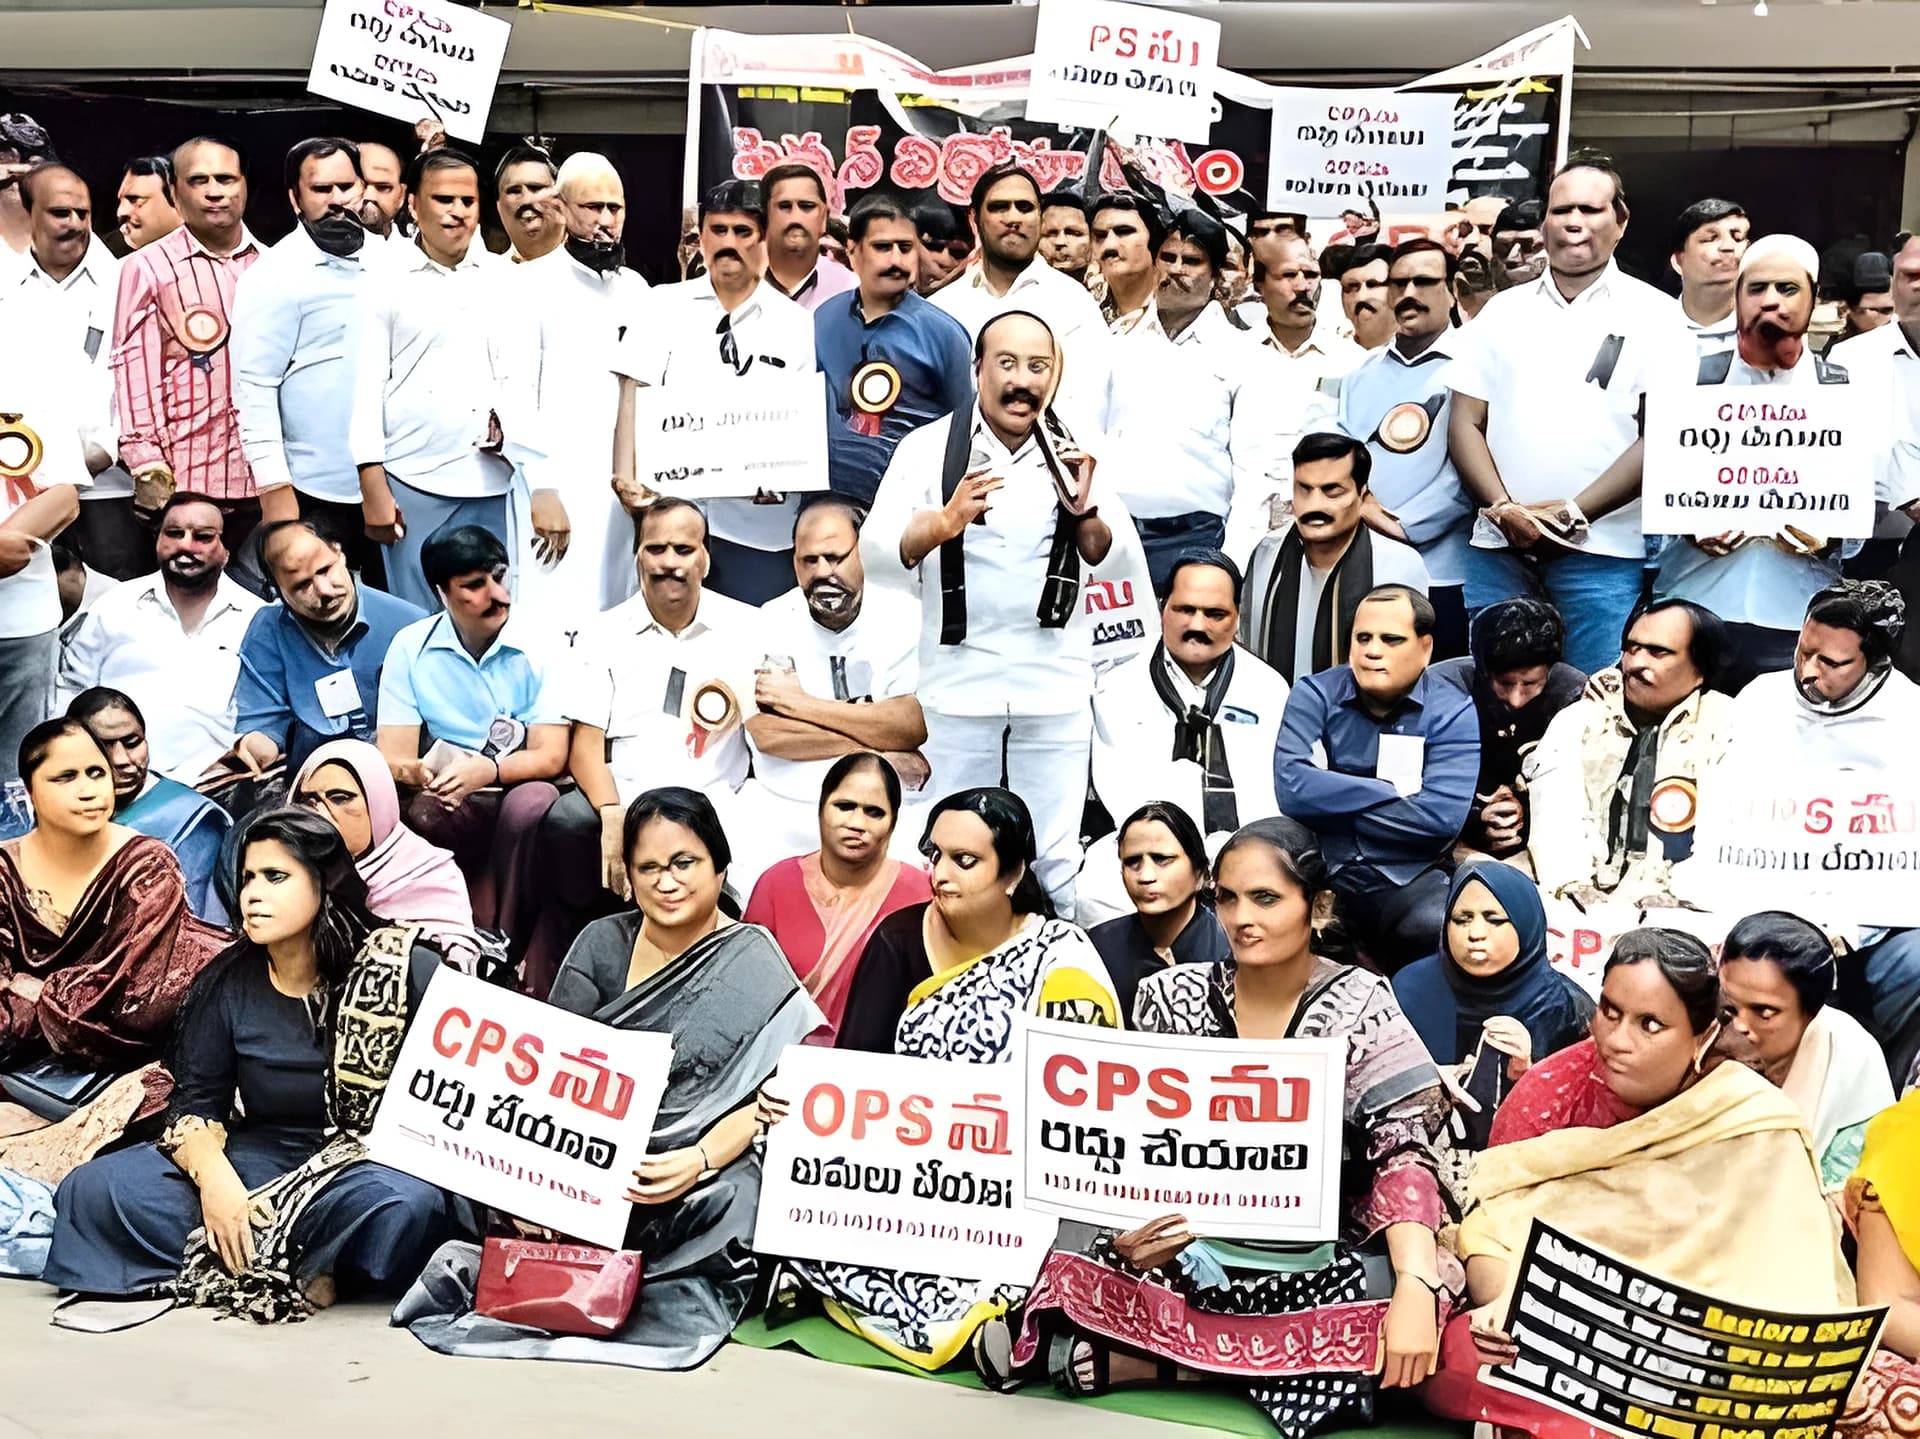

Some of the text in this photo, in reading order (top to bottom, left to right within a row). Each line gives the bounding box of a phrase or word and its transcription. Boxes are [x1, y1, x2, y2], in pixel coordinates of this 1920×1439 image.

[433, 1007, 544, 1086] CPS
[802, 1083, 934, 1147] OPS
[1043, 1054, 1192, 1119] CPS
